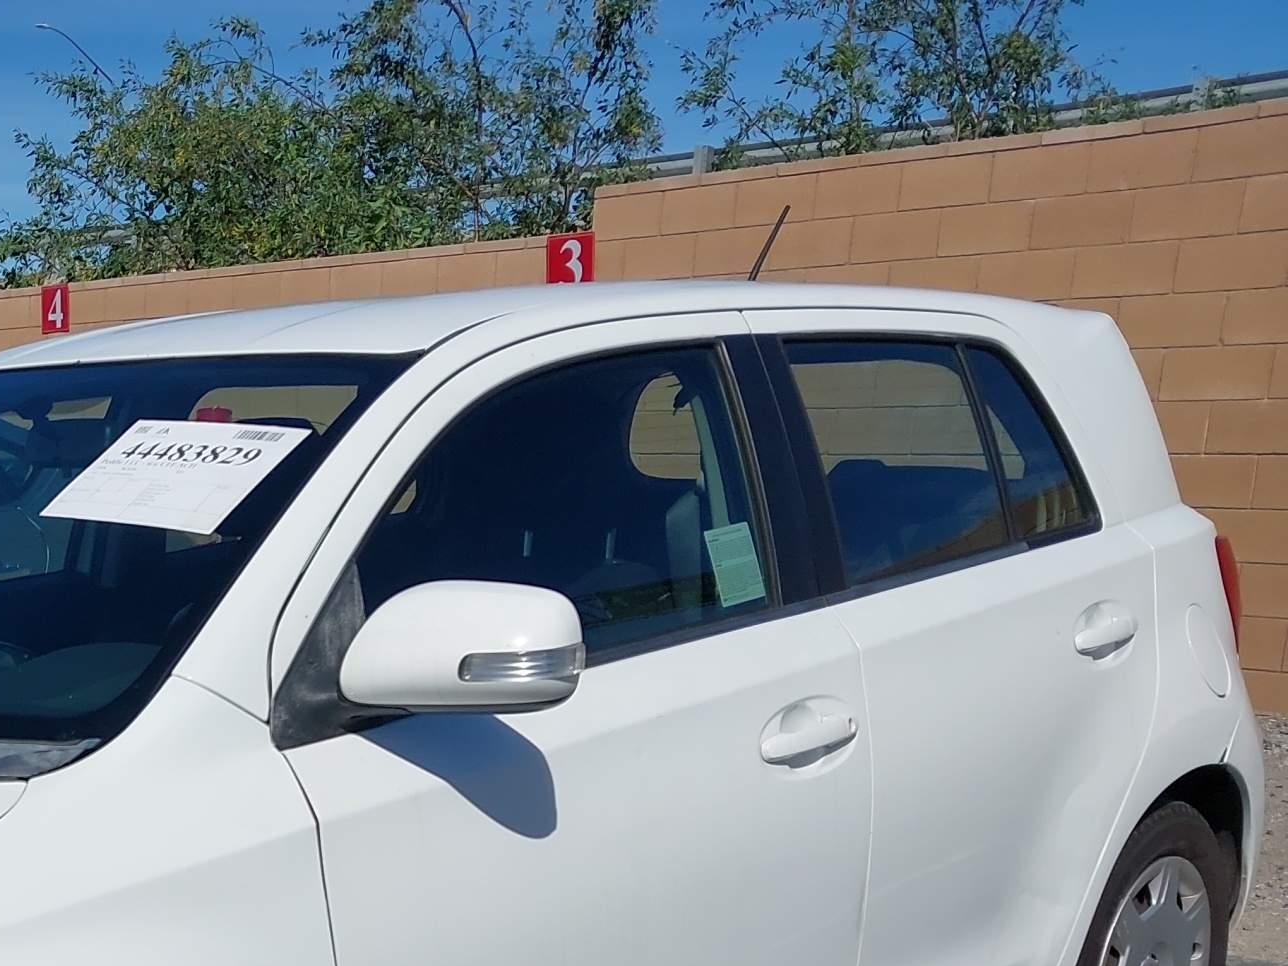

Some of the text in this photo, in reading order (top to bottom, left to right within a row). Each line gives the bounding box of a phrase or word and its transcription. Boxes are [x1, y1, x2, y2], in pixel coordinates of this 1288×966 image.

[559, 239, 583, 284] 3
[47, 288, 64, 329] 4
[121, 441, 263, 466] 44483829
